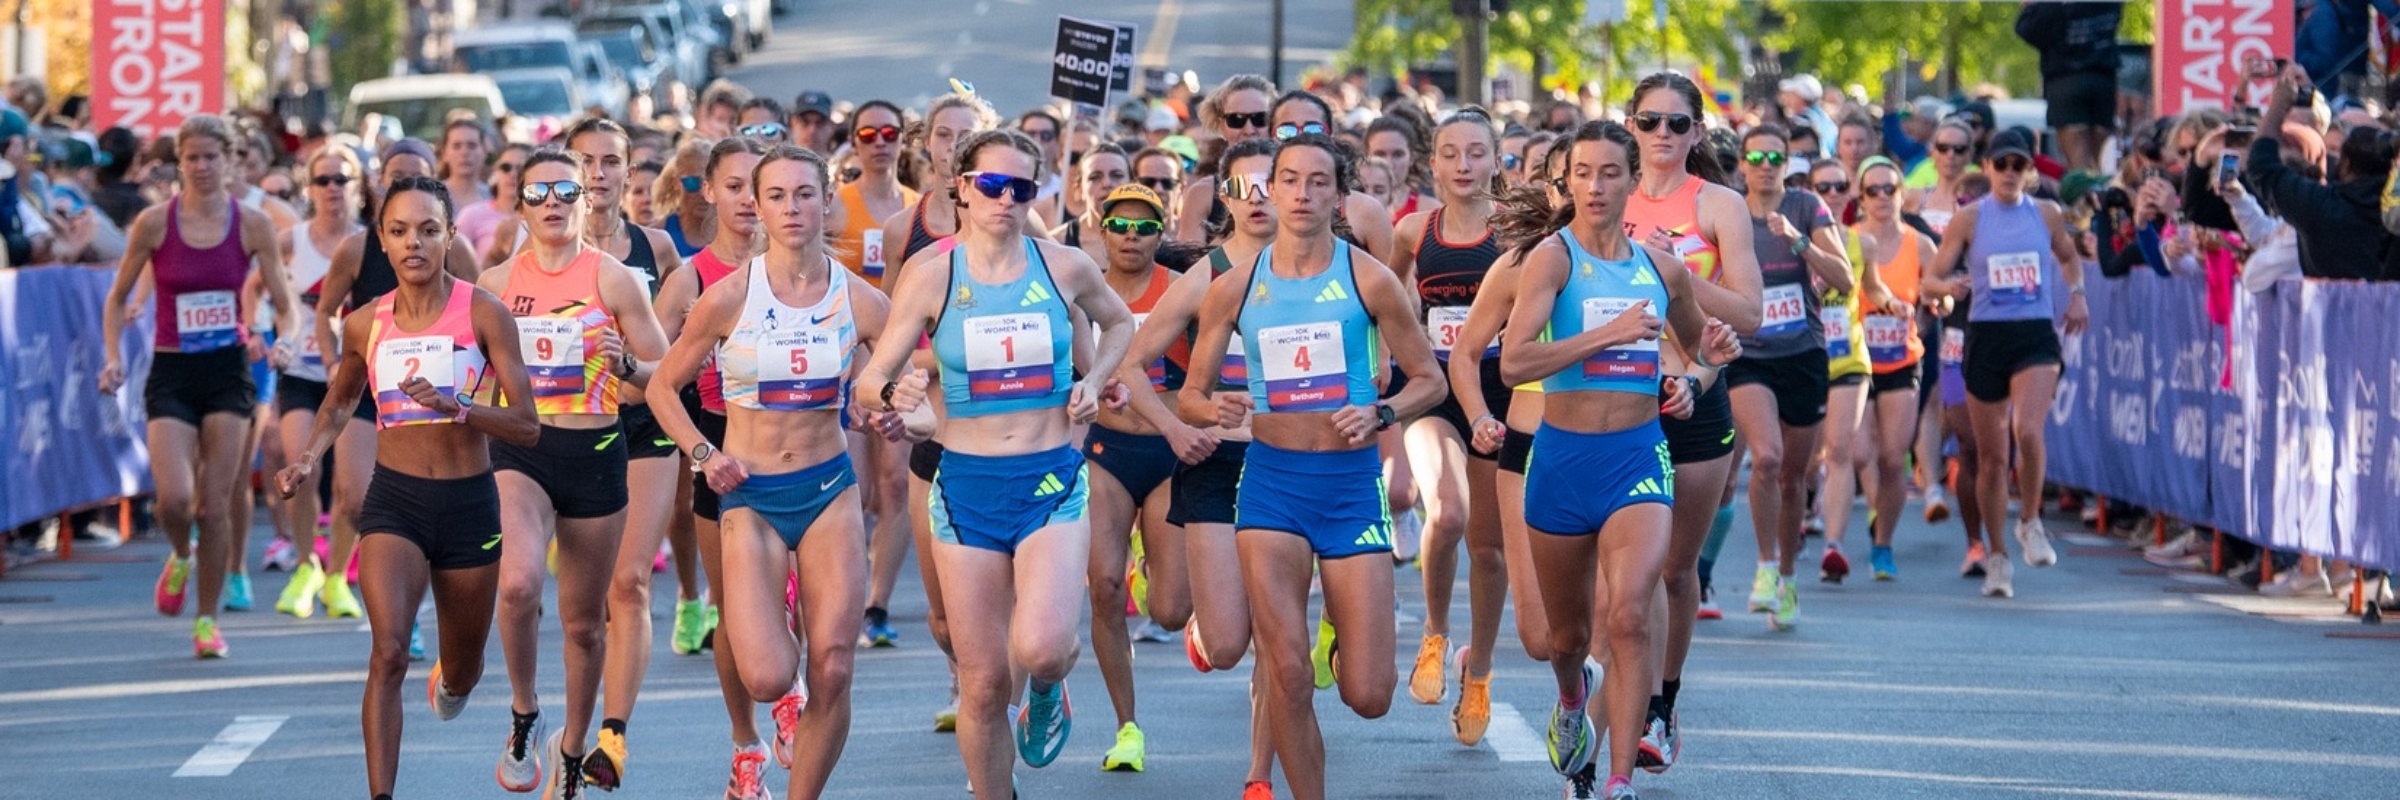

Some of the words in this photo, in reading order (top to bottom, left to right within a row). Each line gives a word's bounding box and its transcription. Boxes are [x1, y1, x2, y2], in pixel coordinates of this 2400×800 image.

[160, 0, 203, 136] TAR
[1055, 52, 1110, 77] 40:00
[867, 244, 884, 263] 3
[1993, 265, 2036, 284] 1330
[184, 306, 231, 327] 1055
[1766, 298, 1802, 320] 443
[536, 337, 553, 361] 9
[775, 338, 808, 346] WOMEN
[1000, 335, 1014, 363] 1
[1278, 335, 1310, 344] WOMEN
[404, 357, 420, 382] 2
[790, 348, 808, 375] 5
[1294, 346, 1312, 372] 4
[1609, 364, 1636, 374] Megan
[1000, 381, 1024, 391] Annie
[789, 392, 812, 402] Emily
[1290, 392, 1325, 402] Bethany
